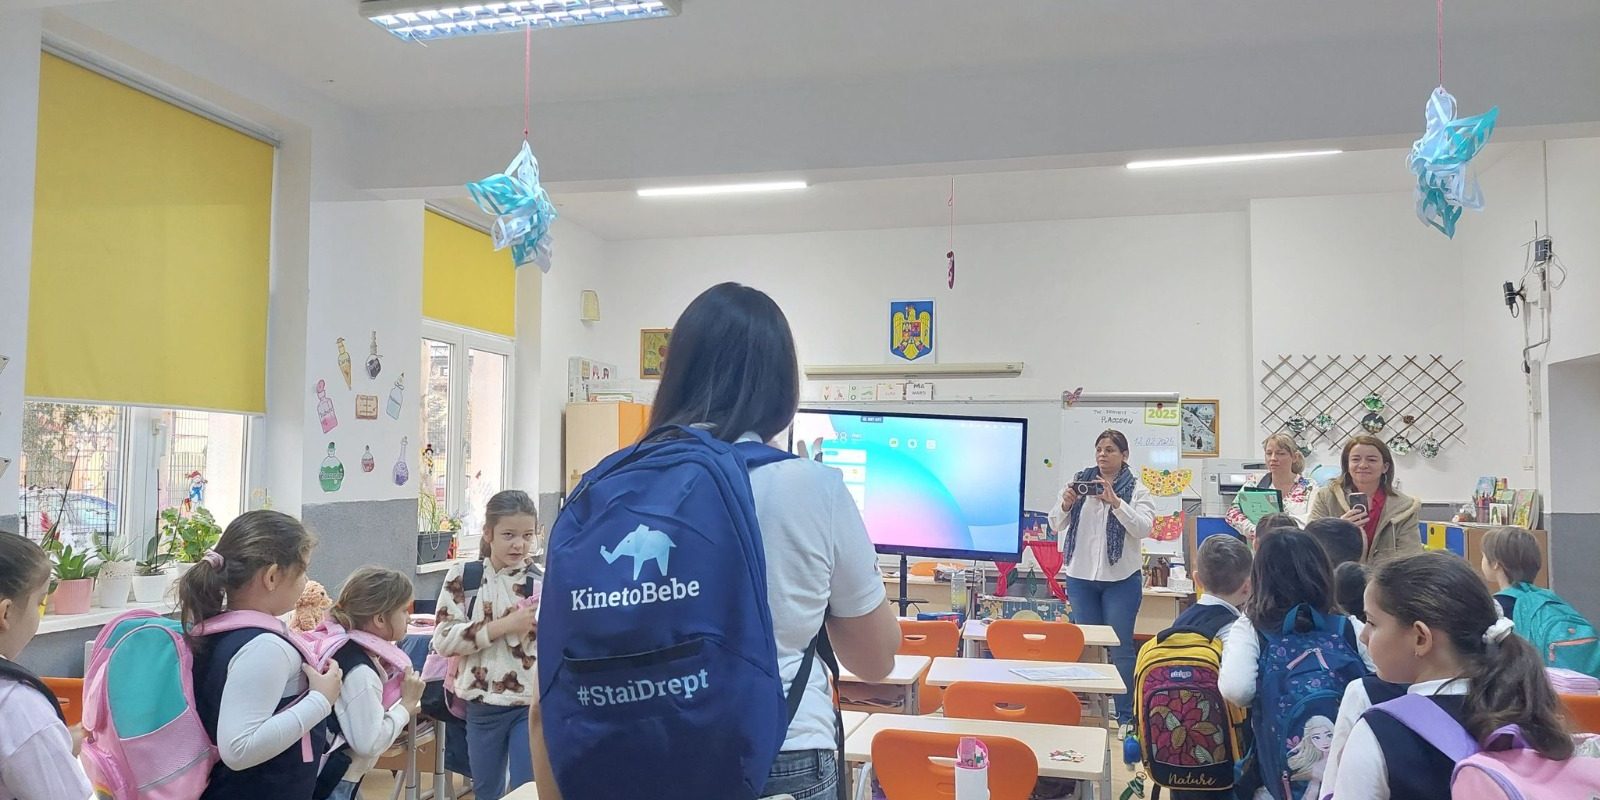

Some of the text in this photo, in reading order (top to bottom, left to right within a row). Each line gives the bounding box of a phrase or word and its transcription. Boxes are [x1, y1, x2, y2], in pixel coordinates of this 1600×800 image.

[1148, 408, 1178, 419] 2025
[571, 577, 699, 610] KinetoBebe
[577, 668, 709, 706] #StaiDrept
[1168, 772, 1216, 785] Nature
